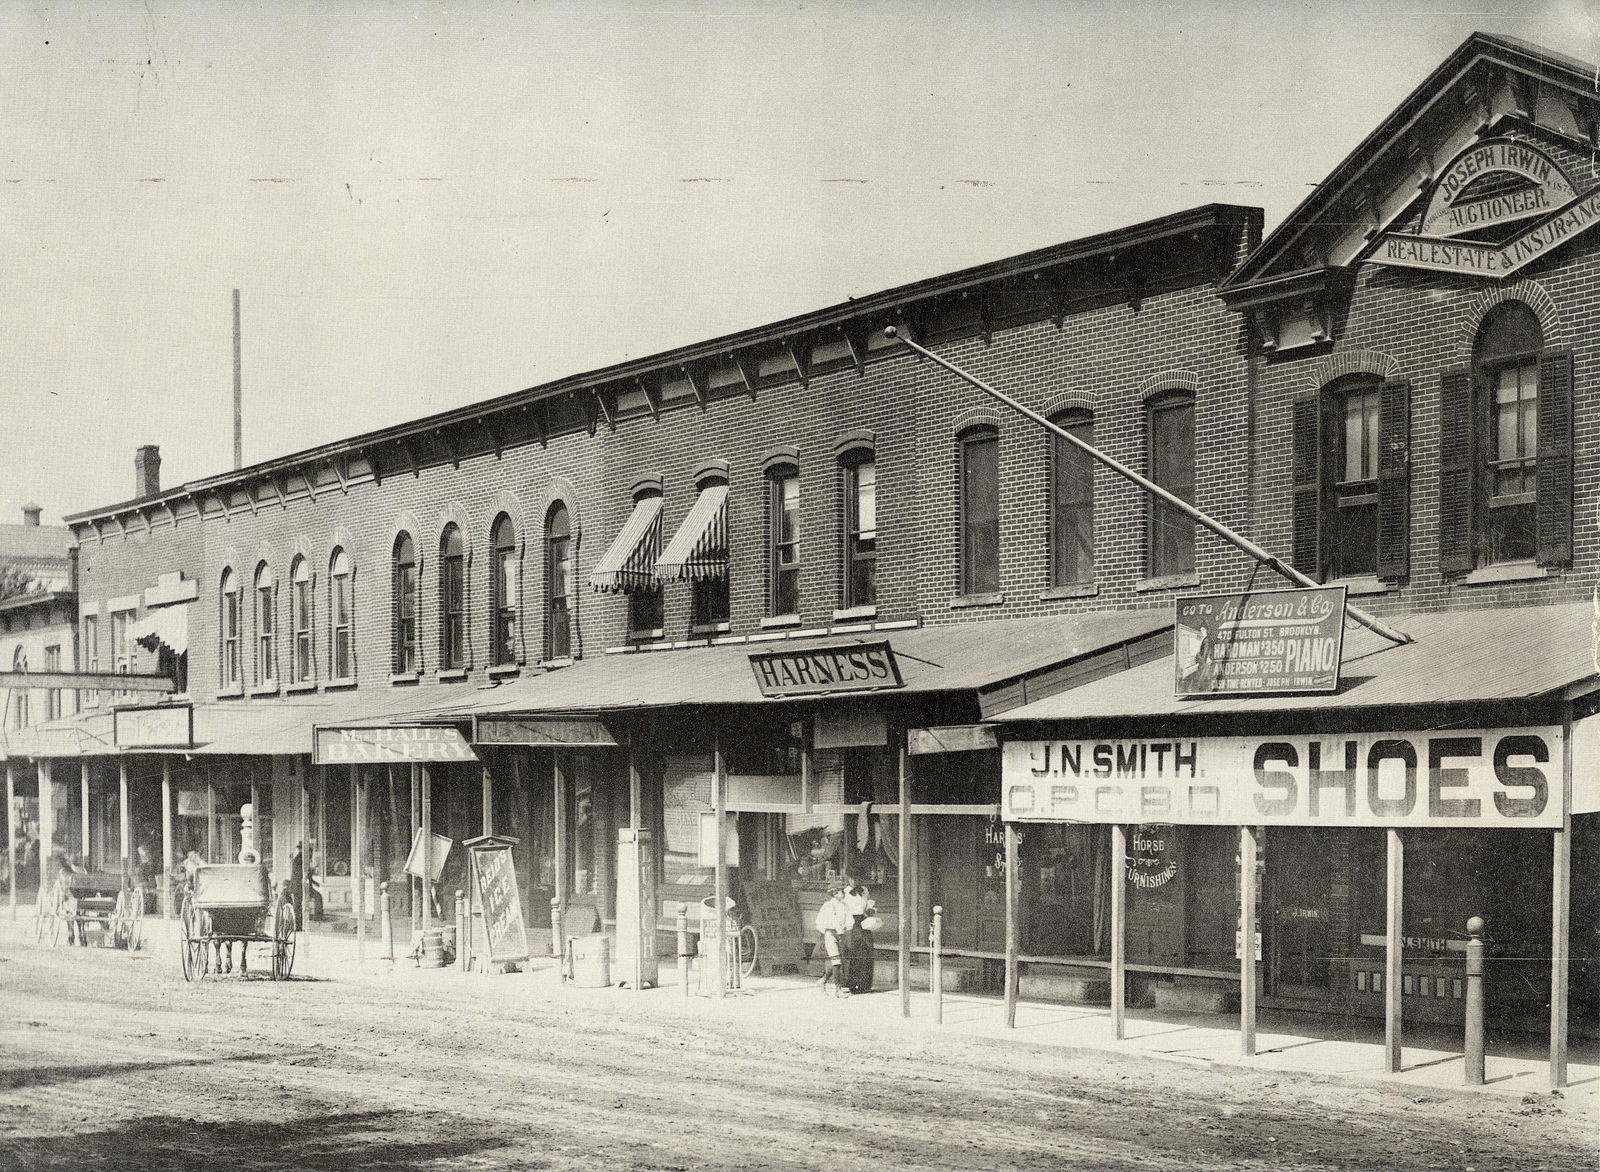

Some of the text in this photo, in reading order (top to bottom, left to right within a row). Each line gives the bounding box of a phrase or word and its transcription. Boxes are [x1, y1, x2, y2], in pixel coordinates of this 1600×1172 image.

[1441, 147, 1495, 202] JOSEPH
[1501, 250, 1514, 269] &
[1182, 605, 1197, 617] GO
[1199, 604, 1214, 615] TO
[1215, 600, 1295, 621] Anderson
[1296, 596, 1308, 616] &
[757, 650, 889, 689] HARNESS
[1253, 734, 1550, 818] SHOES
[1133, 833, 1165, 855] HORSE
